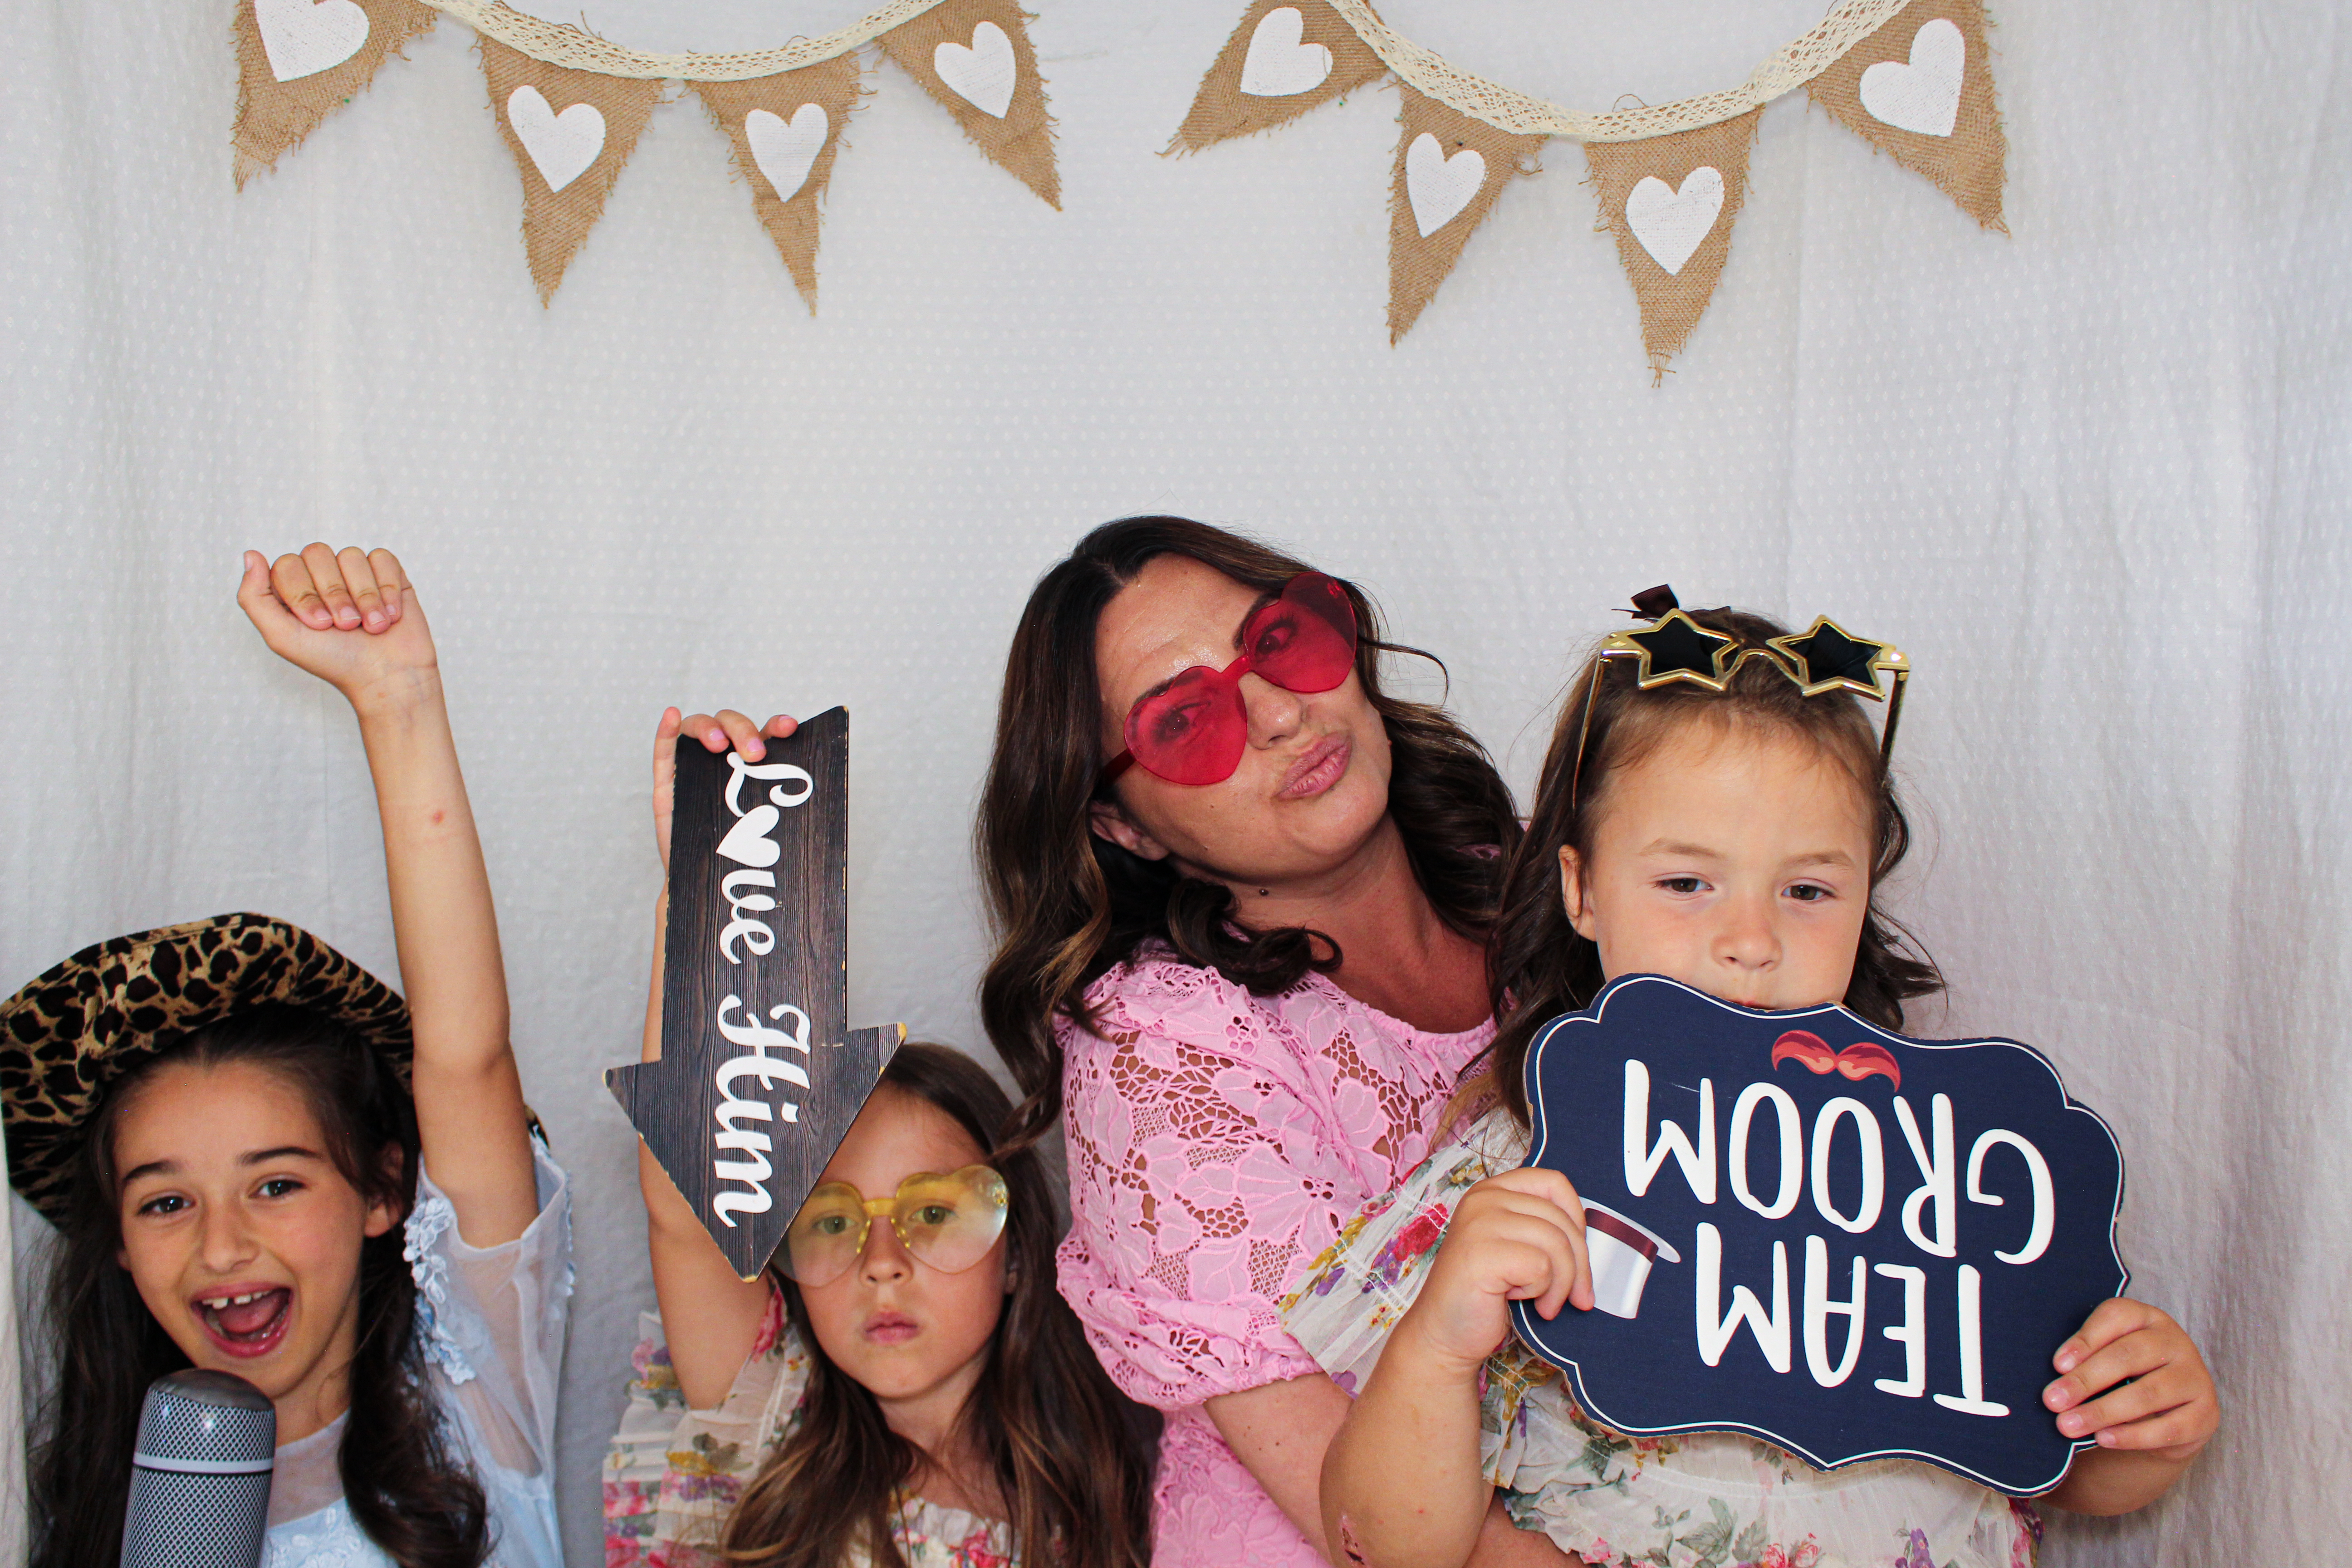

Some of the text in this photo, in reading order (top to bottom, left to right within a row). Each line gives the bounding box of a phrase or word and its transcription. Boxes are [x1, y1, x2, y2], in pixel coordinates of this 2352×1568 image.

[713, 993, 812, 1228] Him
[1623, 1058, 2054, 1265] GROOM
[1695, 1222, 2010, 1417] TEAM
